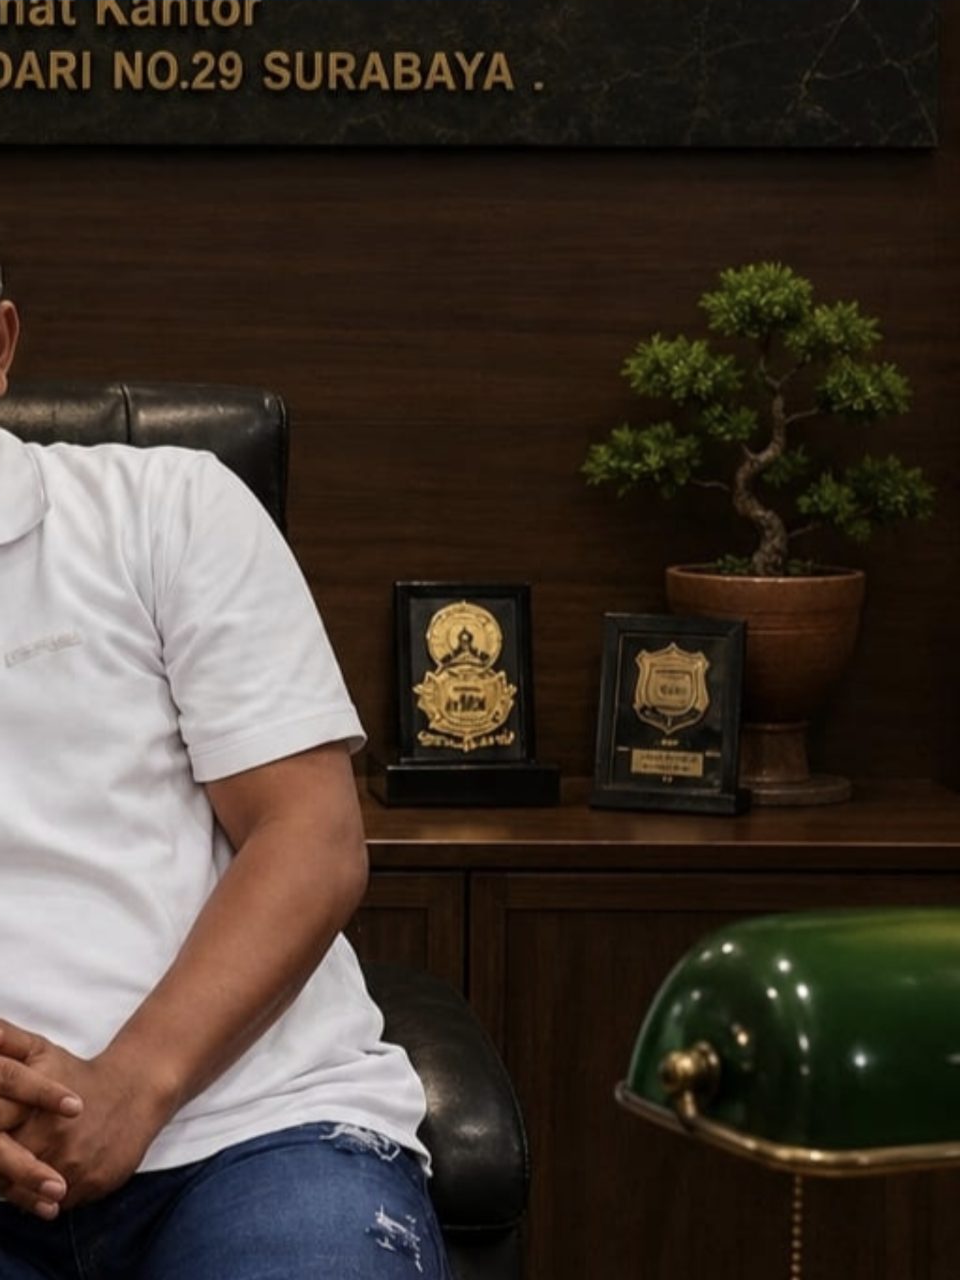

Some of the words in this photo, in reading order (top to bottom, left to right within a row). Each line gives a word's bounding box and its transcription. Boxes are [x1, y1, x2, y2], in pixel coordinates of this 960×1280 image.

[95, 0, 261, 27] Kantor
[113, 50, 243, 90] NO.29
[263, 50, 515, 90] SURABAYA
